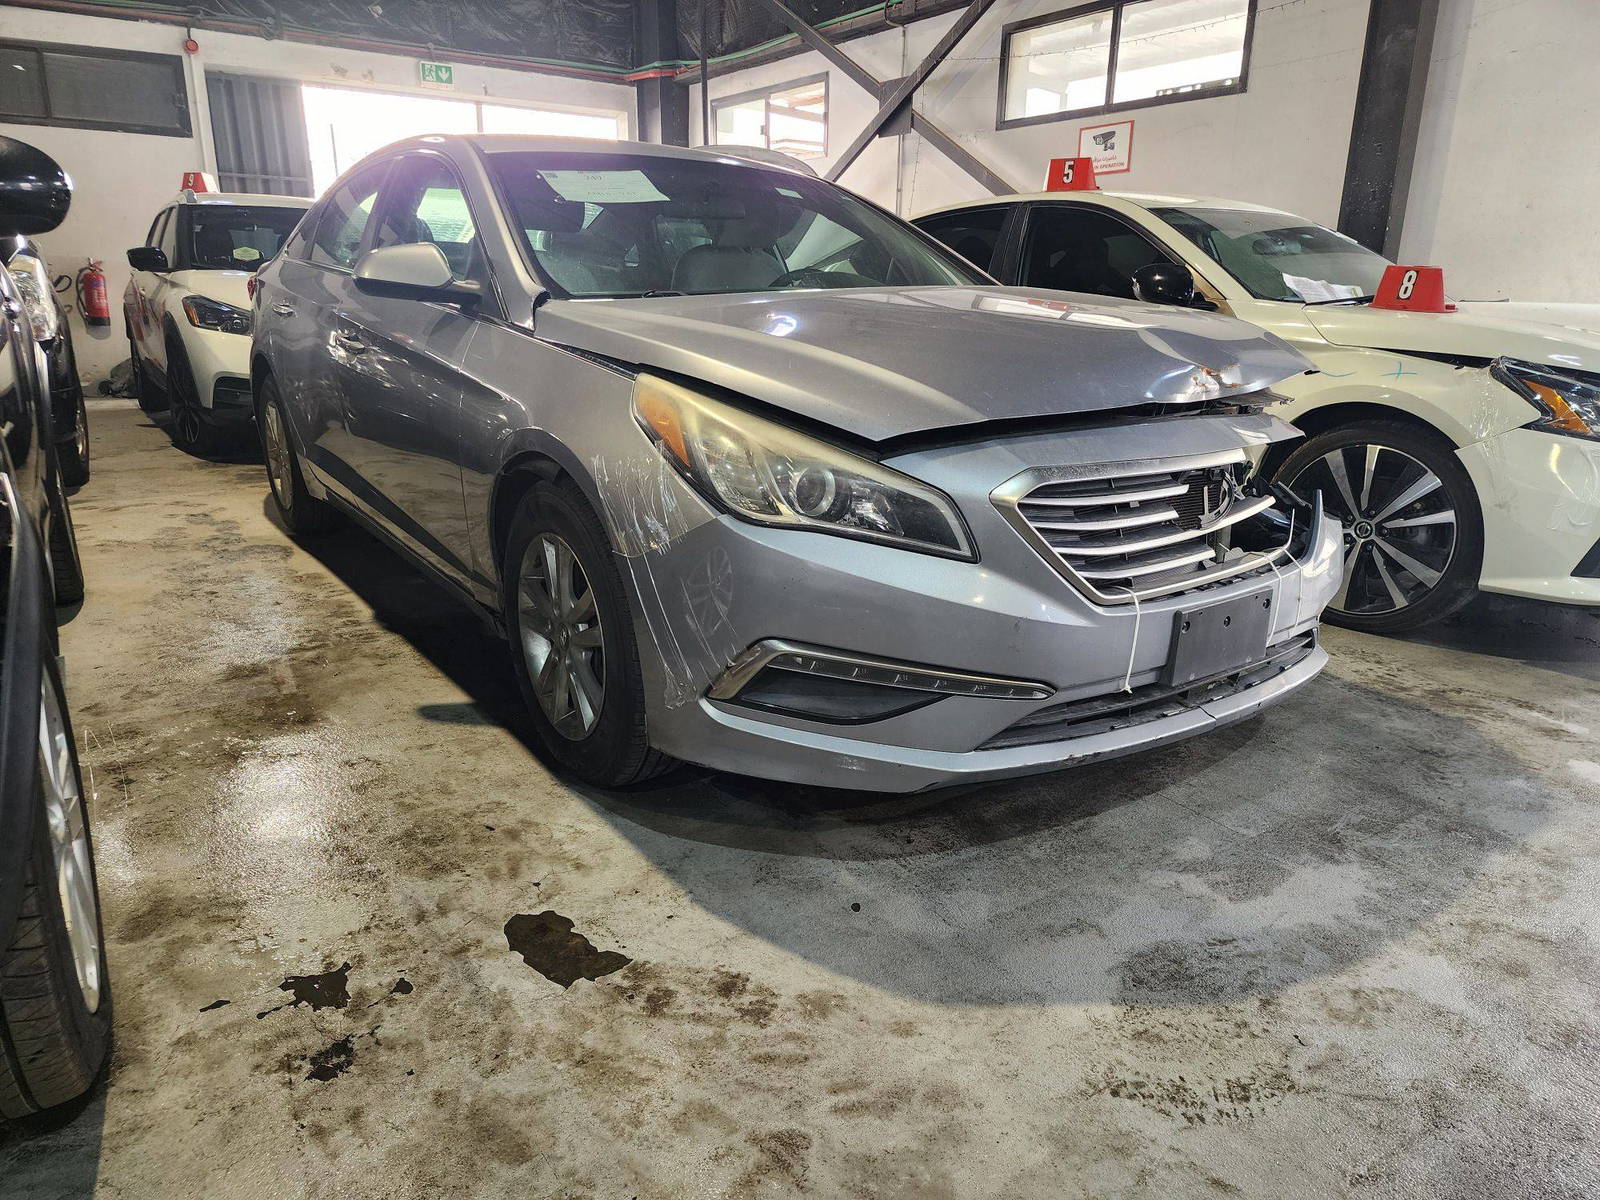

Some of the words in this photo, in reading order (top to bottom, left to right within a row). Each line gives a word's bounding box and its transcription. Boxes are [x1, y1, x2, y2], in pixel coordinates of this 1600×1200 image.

[188, 173, 195, 187] 9
[1062, 159, 1075, 184] 5
[1398, 269, 1418, 300] 8
